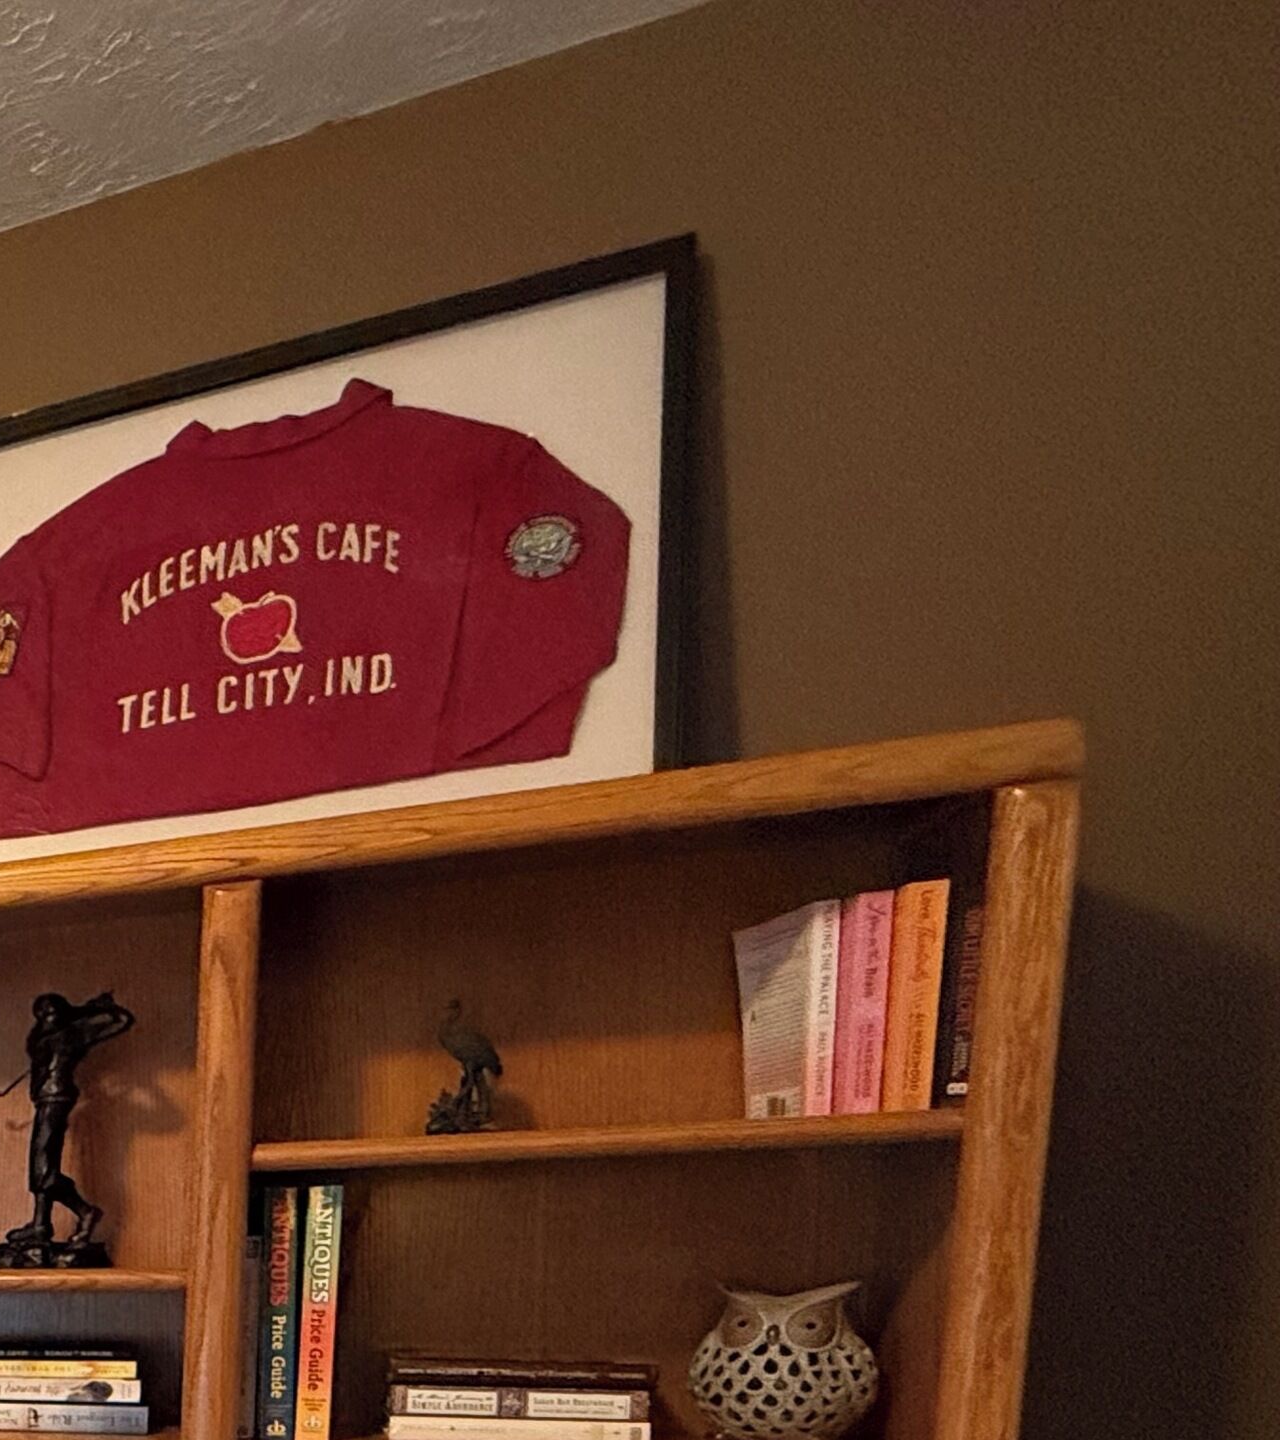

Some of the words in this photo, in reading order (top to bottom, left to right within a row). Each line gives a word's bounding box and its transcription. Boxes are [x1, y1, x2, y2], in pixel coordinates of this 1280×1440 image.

[120, 524, 300, 625] KLEEMAN'S
[316, 522, 401, 574] CAFE
[117, 683, 196, 733] TELL
[325, 652, 397, 697] IND.
[270, 1199, 290, 1306] ANTIQUES
[310, 1192, 333, 1304] ANTIQUES
[271, 1315, 287, 1350] Price
[311, 1308, 327, 1344] Price
[270, 1356, 286, 1399] Guide
[307, 1349, 324, 1391] Guide
